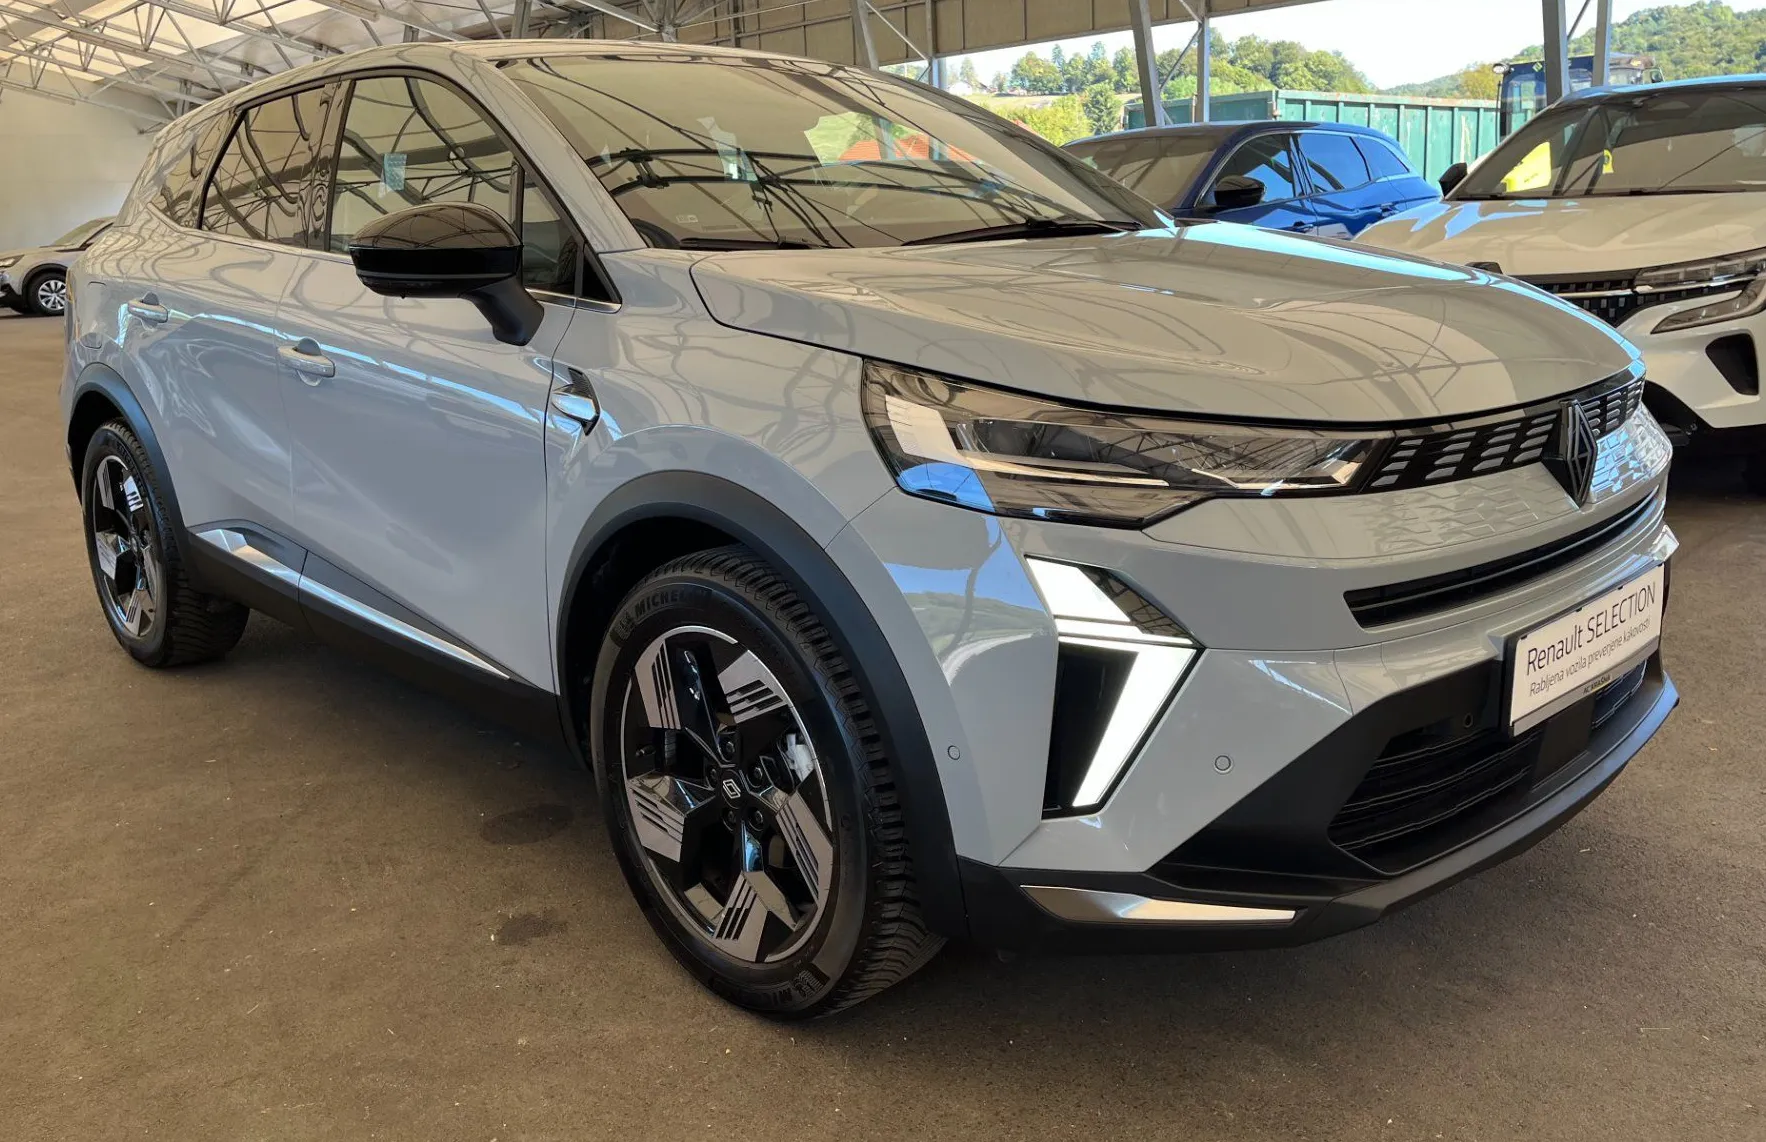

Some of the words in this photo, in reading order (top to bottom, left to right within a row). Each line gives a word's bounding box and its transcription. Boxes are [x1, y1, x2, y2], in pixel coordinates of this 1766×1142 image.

[1527, 624, 1583, 676] Renault
[1587, 581, 1656, 644] SELECTION
[1530, 670, 1564, 697] Rabljena
[1566, 656, 1587, 677] vozila
[1588, 635, 1622, 668] preverjene
[1623, 617, 1651, 642] kakovosti
